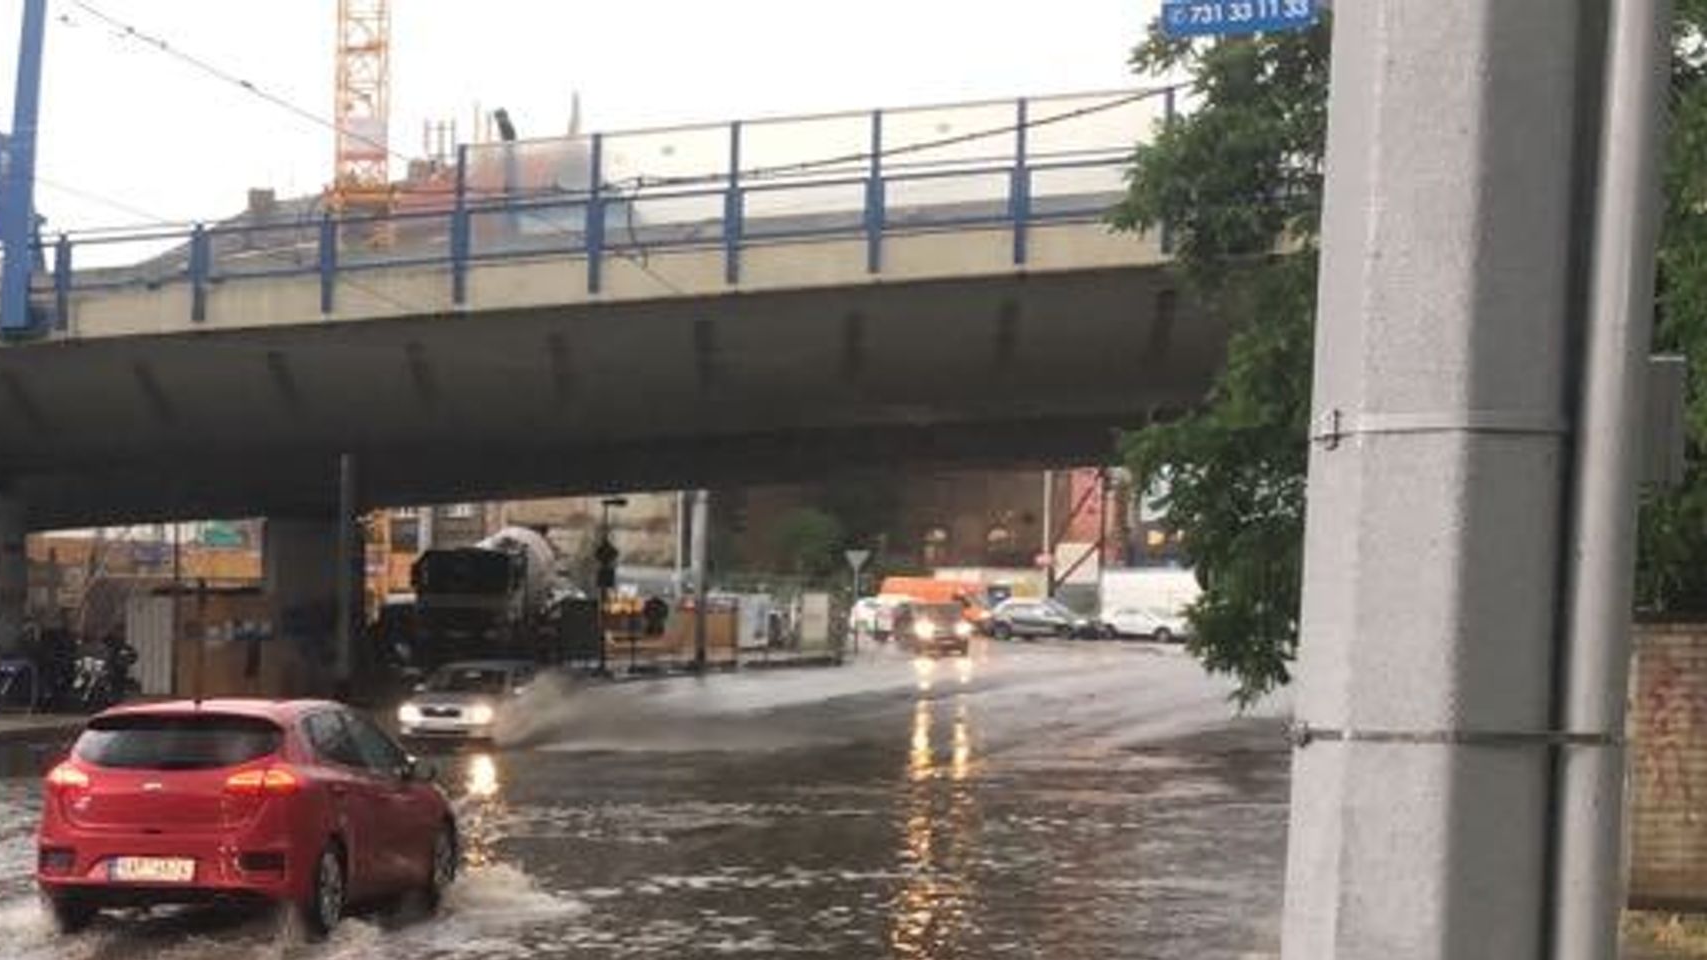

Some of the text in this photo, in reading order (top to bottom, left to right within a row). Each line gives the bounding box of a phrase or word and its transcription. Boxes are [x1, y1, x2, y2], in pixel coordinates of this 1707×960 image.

[1190, 3, 1223, 24] 731
[1228, 3, 1253, 22] 33
[1258, 0, 1279, 18] 11
